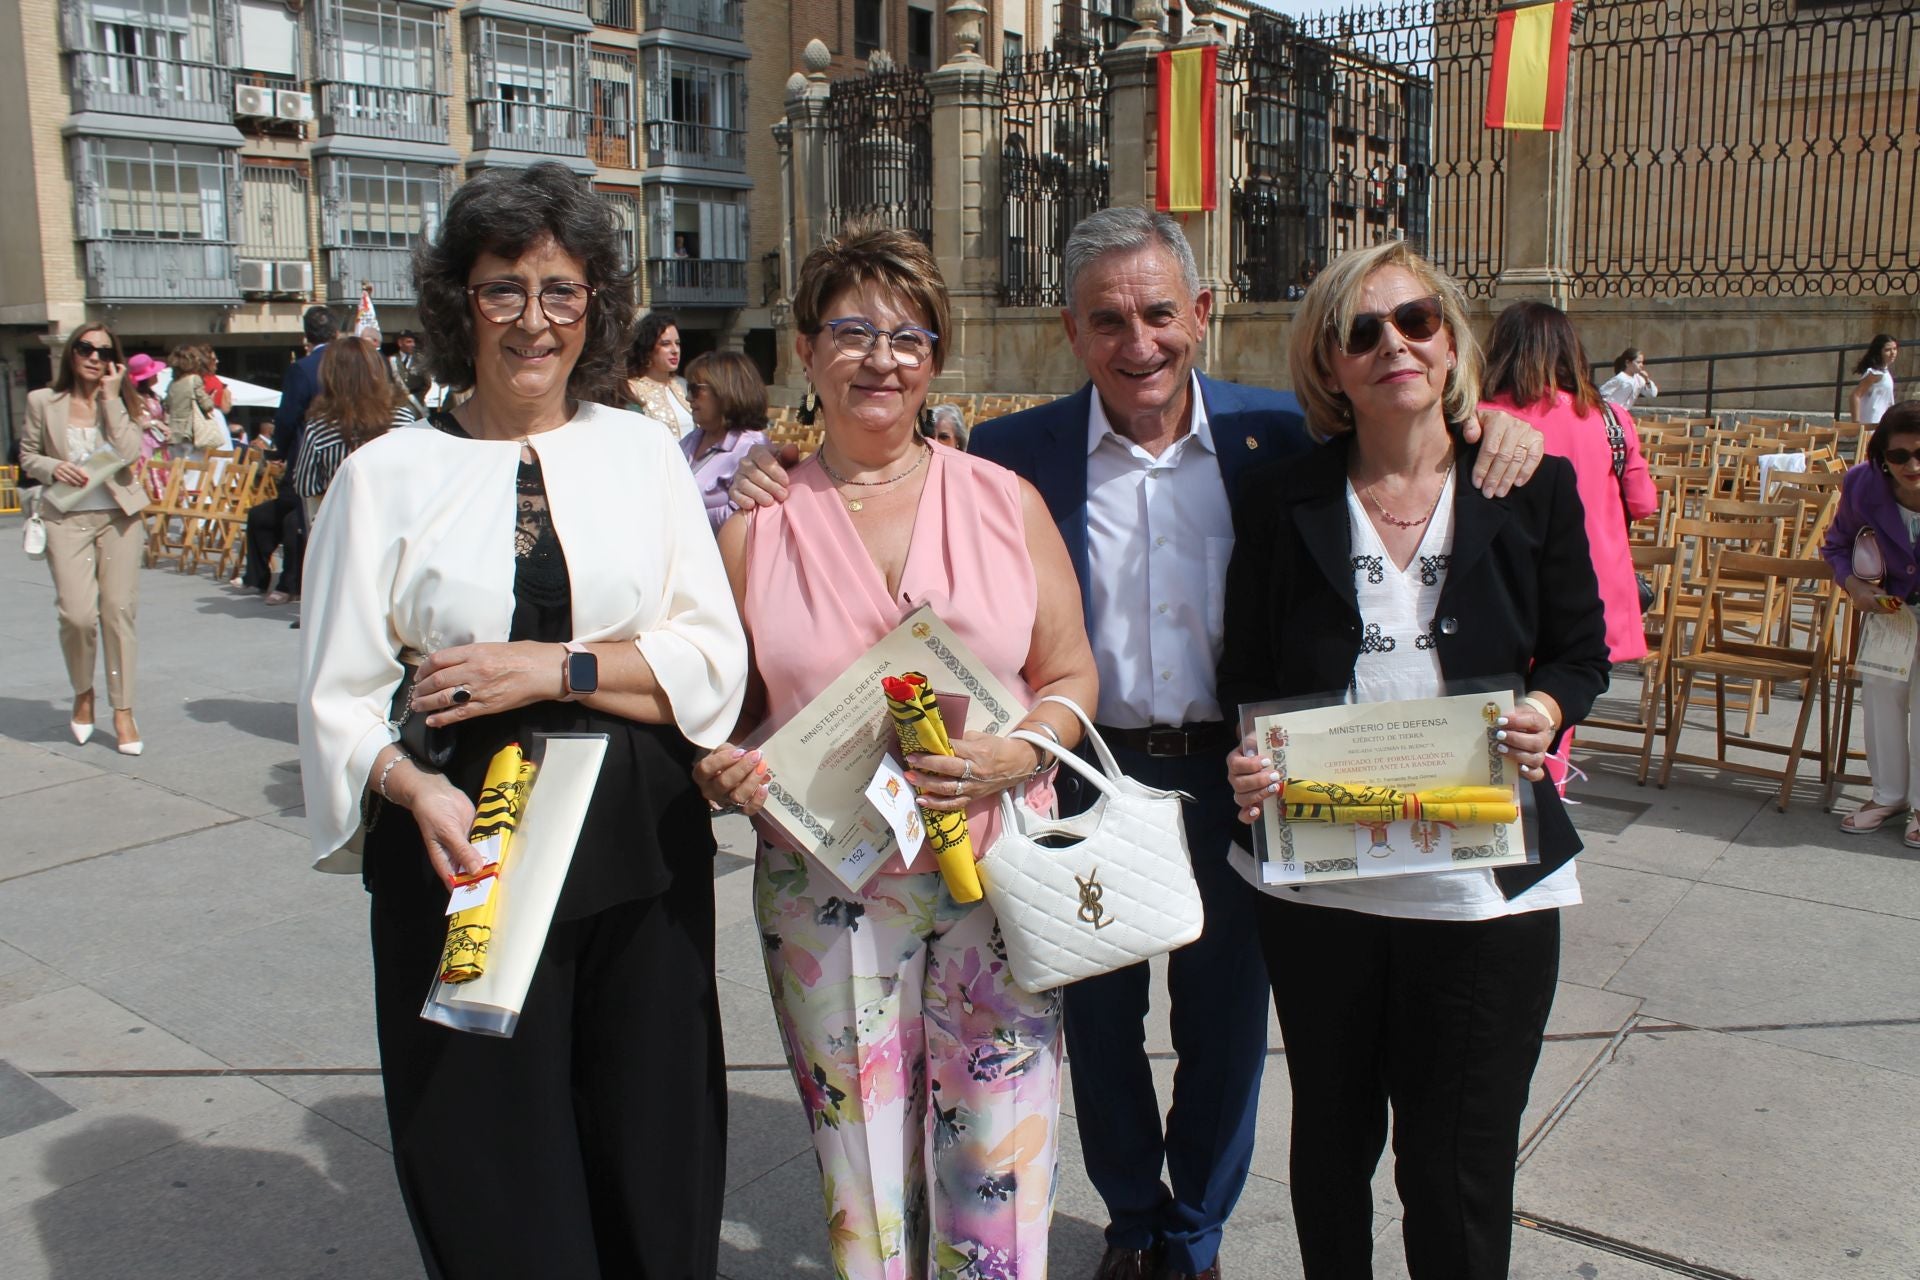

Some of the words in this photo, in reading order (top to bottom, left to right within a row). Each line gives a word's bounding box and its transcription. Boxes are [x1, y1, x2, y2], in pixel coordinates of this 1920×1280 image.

[800, 704, 844, 745] MINISTERIO
[844, 694, 857, 705] DE
[855, 660, 892, 694] DEFENSA
[1329, 722, 1384, 736] MINISTERIO
[1386, 721, 1400, 730] DE
[1402, 717, 1448, 729] DEFENSA
[1399, 732, 1424, 740] TIERRA
[1324, 758, 1371, 768] CERTIFICADO
[1387, 752, 1440, 762] FORMULACIÓN
[1335, 765, 1377, 774] JURAMENTO
[1380, 763, 1399, 771] ANTE
[1412, 760, 1446, 768] BANDERA
[848, 848, 865, 866] 152
[1283, 863, 1295, 872] 70
